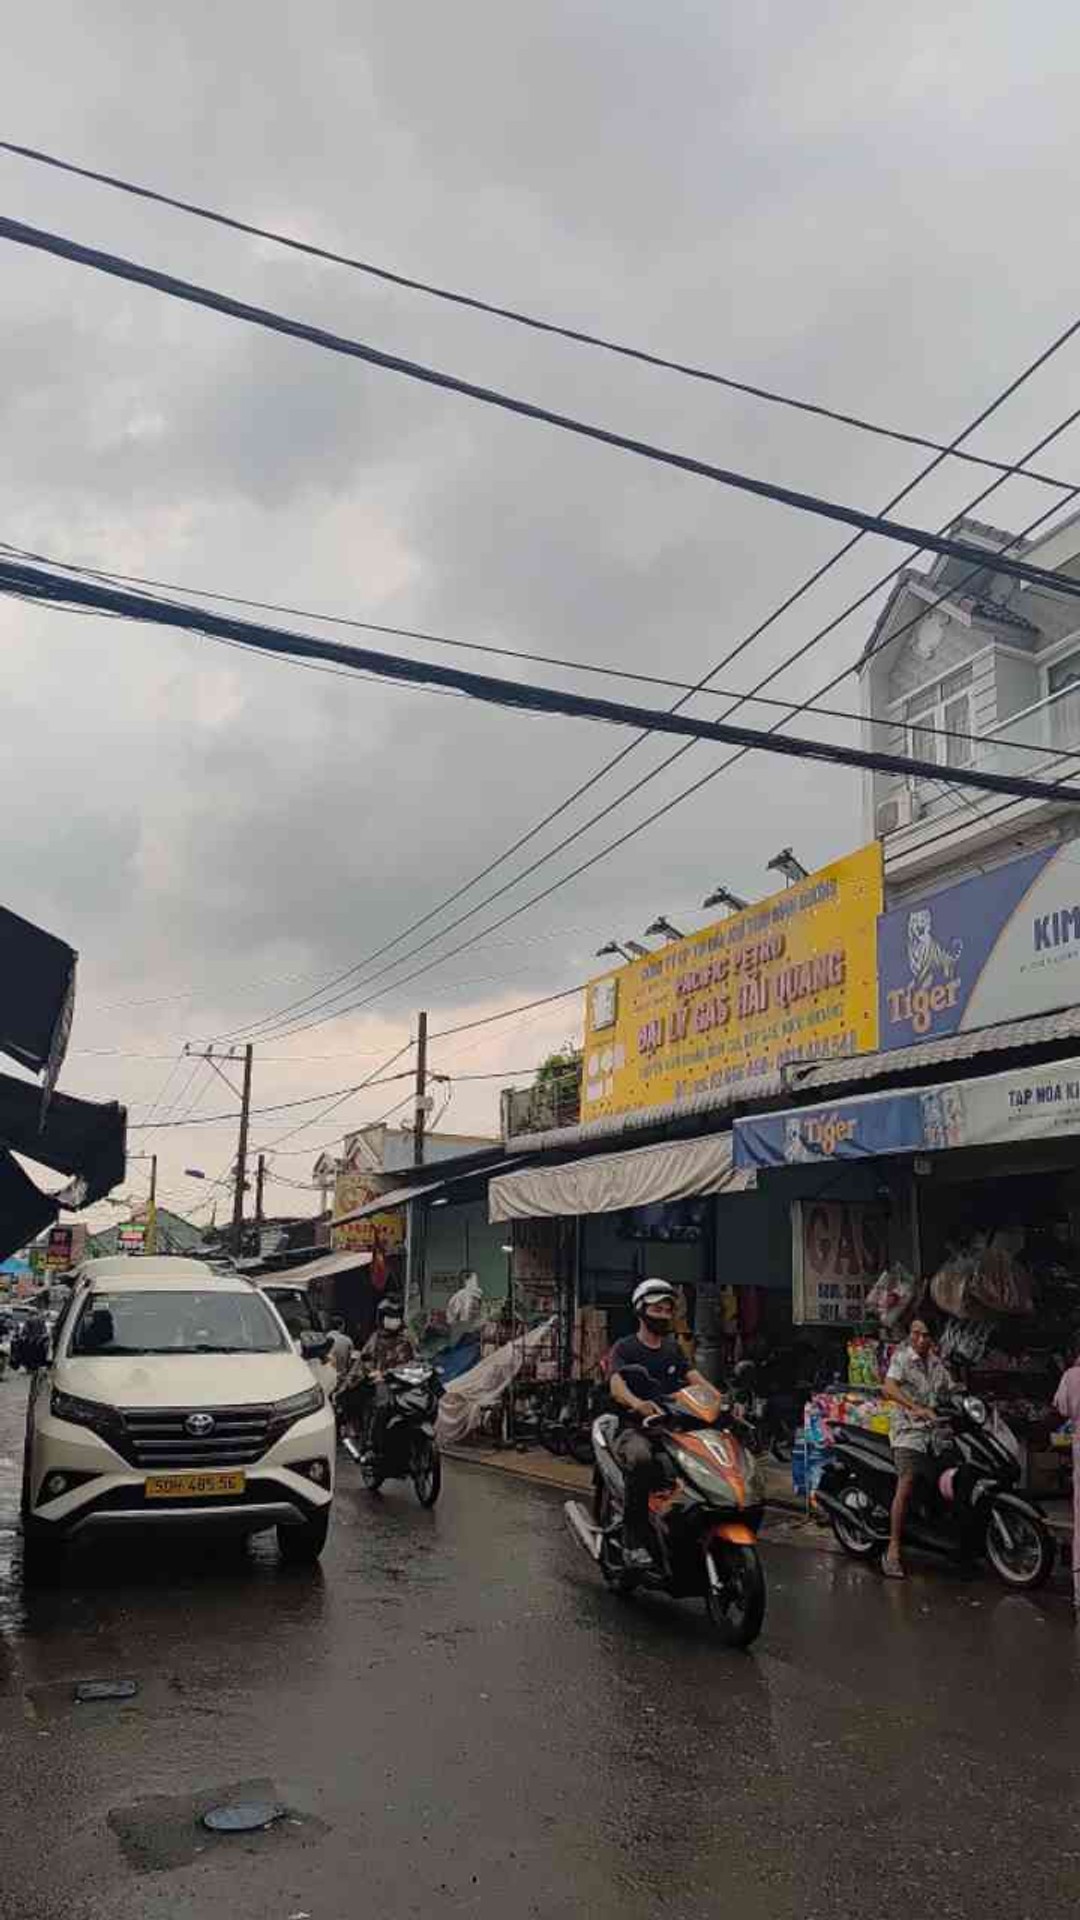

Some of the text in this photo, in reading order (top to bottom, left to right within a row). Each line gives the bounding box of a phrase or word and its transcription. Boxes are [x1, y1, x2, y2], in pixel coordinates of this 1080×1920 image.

[675, 958, 730, 996] PACIFIC
[731, 934, 786, 973] PETRO
[694, 996, 730, 1034] GAS
[775, 949, 847, 1009] QUANG
[888, 976, 961, 1033] Tiger
[1008, 1089, 1033, 1113] TẠP
[804, 1111, 857, 1153] Tiger
[805, 1206, 889, 1275] GAS
